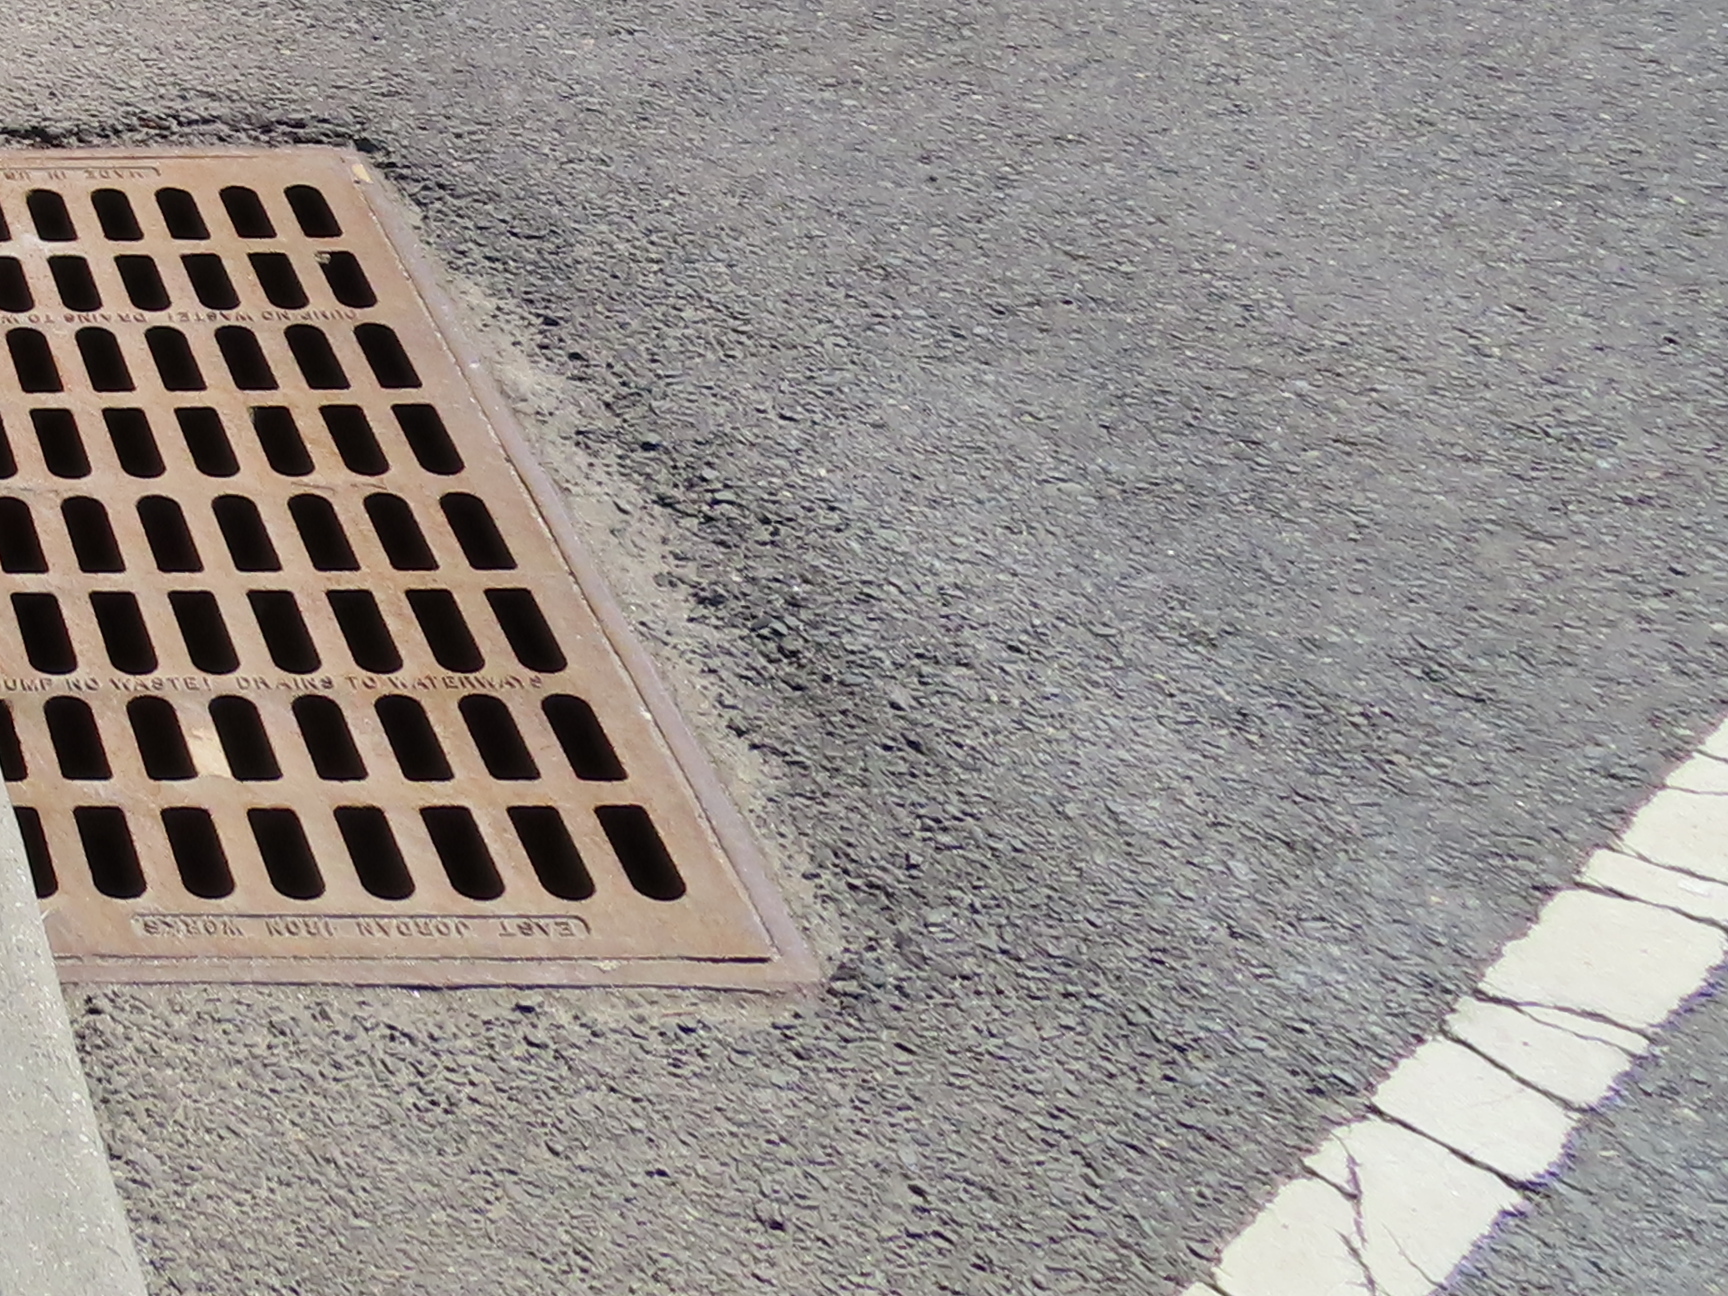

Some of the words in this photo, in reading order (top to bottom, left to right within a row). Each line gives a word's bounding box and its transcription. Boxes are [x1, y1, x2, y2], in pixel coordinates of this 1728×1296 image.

[28, 312, 55, 324] TO
[64, 311, 147, 324] DRAINS
[262, 310, 291, 322] NO
[65, 677, 101, 692] NO
[109, 676, 212, 692] WASTE!
[235, 675, 335, 691] DRAINS
[345, 675, 377, 690] TO
[388, 674, 542, 690] WATERWAYS
[143, 916, 244, 937] WORKS
[265, 917, 335, 937] IRON
[356, 918, 470, 938] JORDAN
[498, 919, 575, 937] EAST
